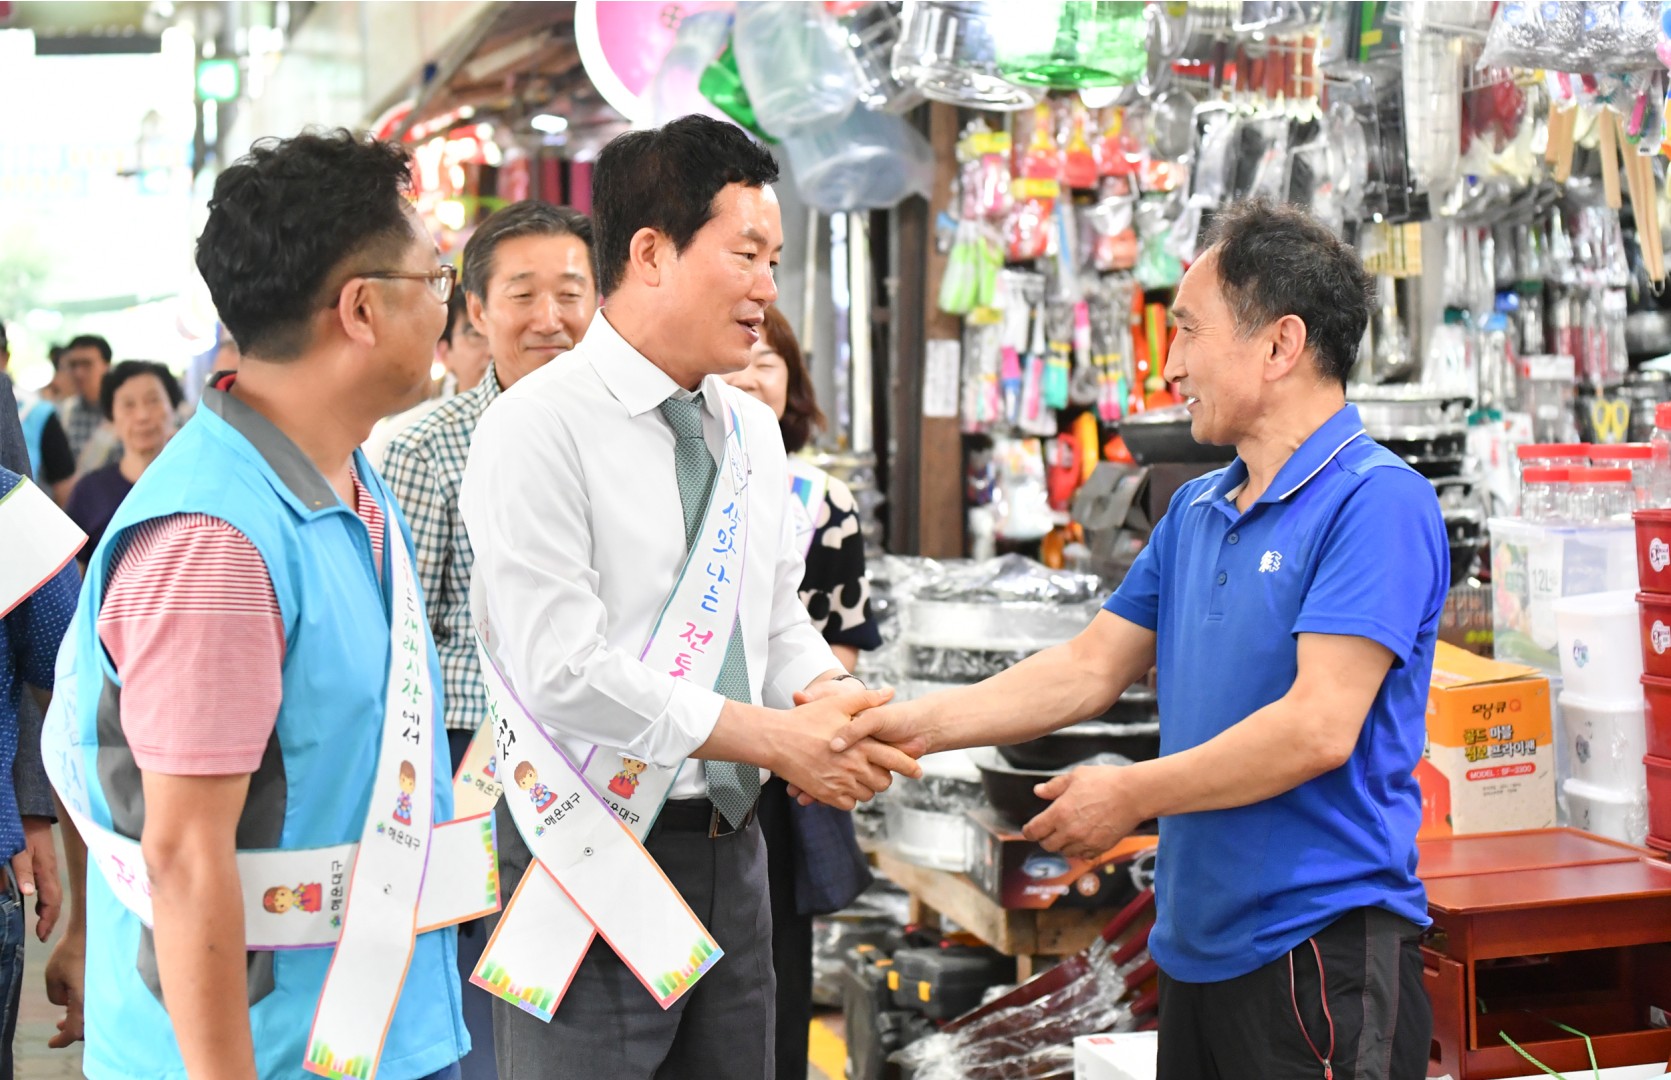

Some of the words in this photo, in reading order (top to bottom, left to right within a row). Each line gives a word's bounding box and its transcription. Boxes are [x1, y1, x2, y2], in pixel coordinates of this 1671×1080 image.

[1490, 724, 1514, 741] 마블
[543, 792, 582, 827] 해운대구
[388, 826, 421, 851] 해운대구
[331, 860, 344, 911] 해운대구
